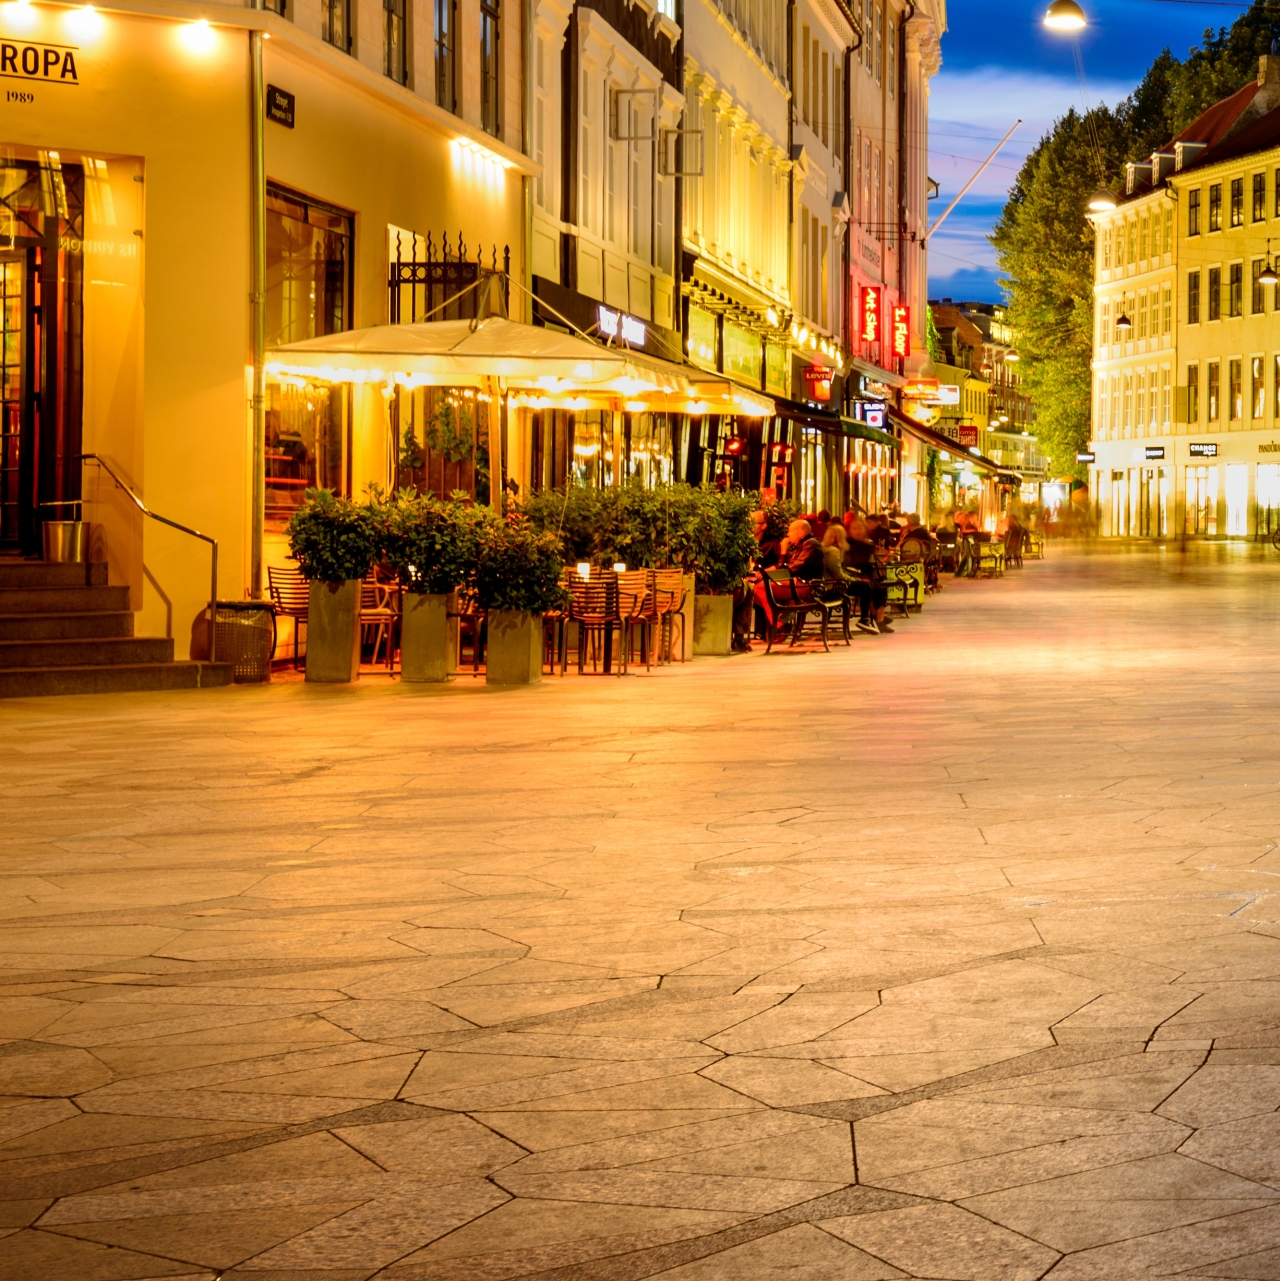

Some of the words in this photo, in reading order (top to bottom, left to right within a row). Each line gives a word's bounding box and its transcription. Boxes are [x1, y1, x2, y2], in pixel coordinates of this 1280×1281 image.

[0, 43, 79, 80] ROPA
[6, 90, 35, 104] 1989
[866, 287, 877, 310] Art
[862, 311, 878, 341] Shop
[894, 307, 906, 321] 1.
[894, 323, 908, 356] Floor
